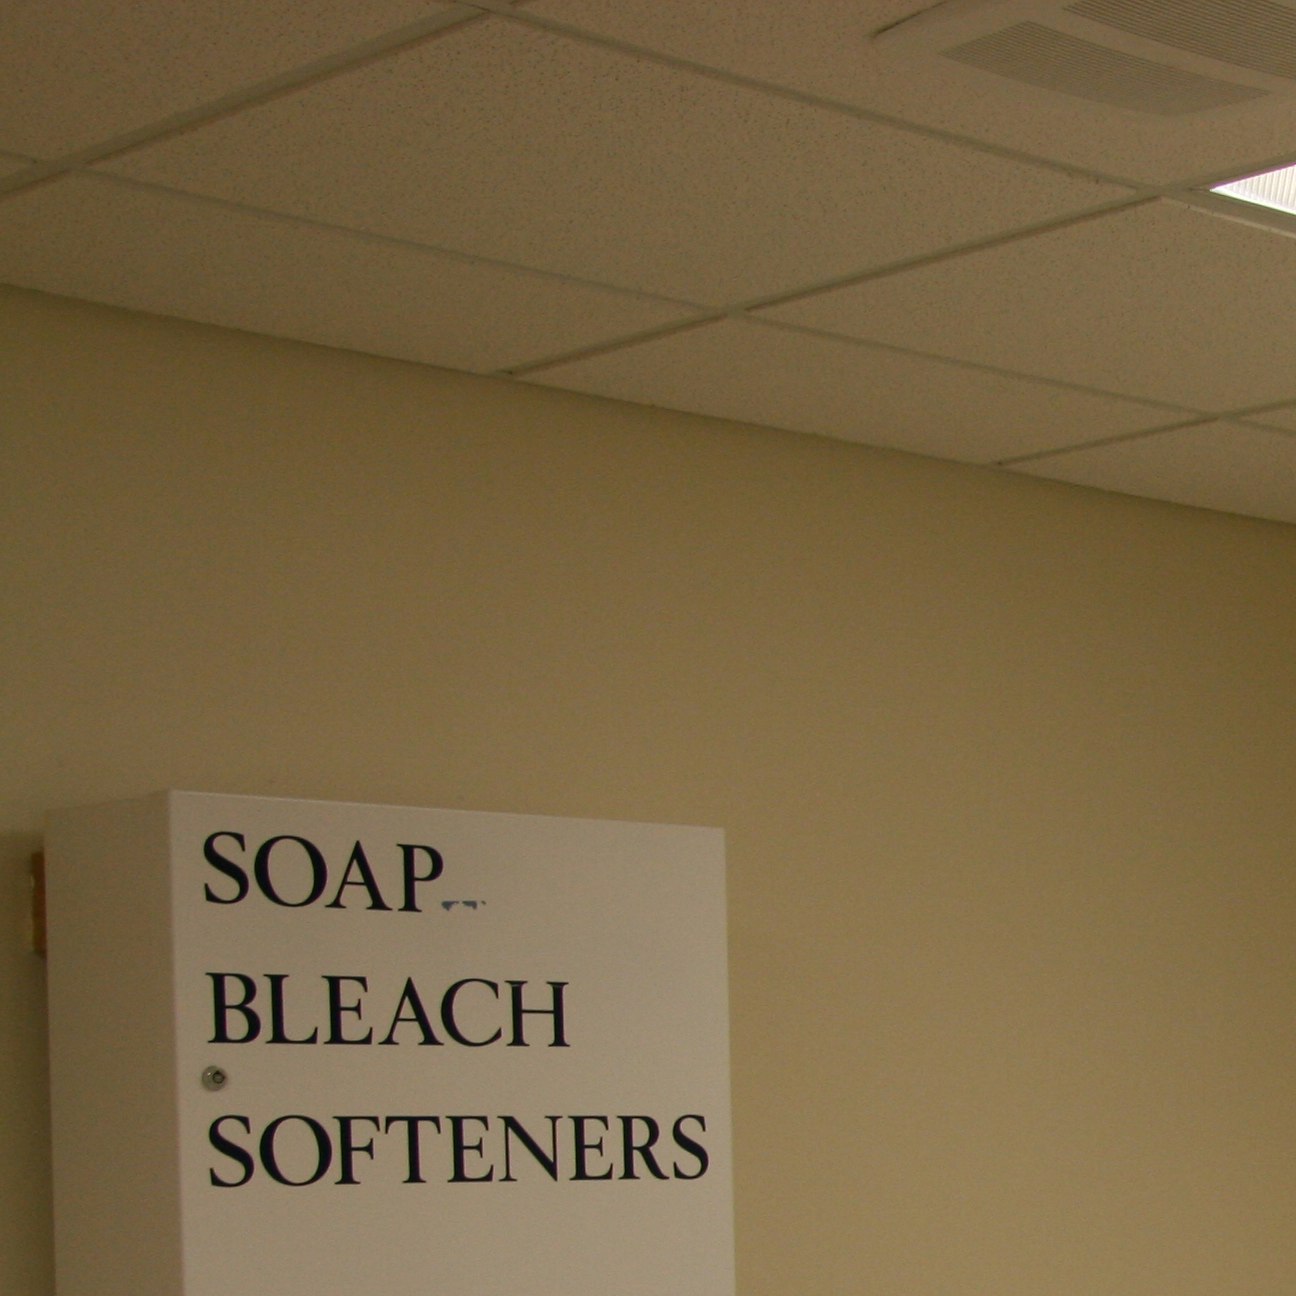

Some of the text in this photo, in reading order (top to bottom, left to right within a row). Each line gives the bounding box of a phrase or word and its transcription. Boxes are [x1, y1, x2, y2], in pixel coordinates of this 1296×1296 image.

[202, 830, 444, 912] SOAP
[205, 972, 571, 1048] BLEACH
[208, 1114, 709, 1188] SOFTENERS
